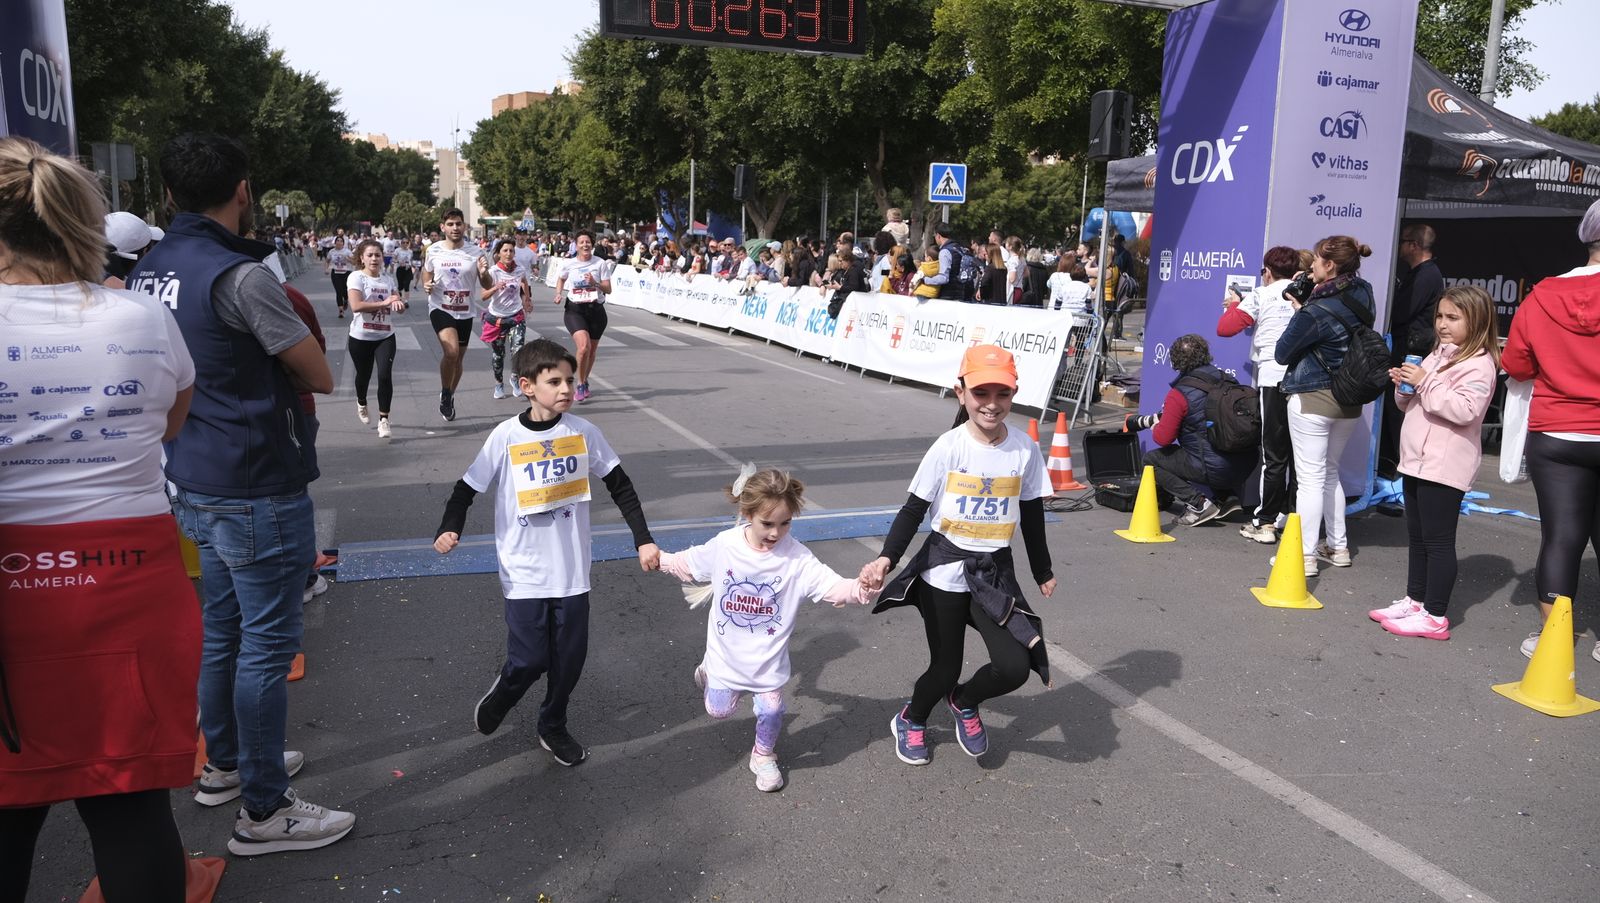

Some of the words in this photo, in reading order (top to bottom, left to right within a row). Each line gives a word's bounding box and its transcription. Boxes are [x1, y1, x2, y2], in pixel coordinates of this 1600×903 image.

[1325, 32, 1380, 49] HYUNDAI
[1331, 46, 1373, 60] Almerialva
[21, 48, 66, 126] CDX
[1335, 75, 1380, 90] cajamar
[1320, 116, 1359, 139] CASI
[1171, 133, 1243, 185] CDX
[1329, 155, 1369, 171] vithas
[1316, 203, 1362, 220] aqualia
[1182, 249, 1245, 268] ALMERÍA
[1181, 269, 1211, 280] CIUDAD
[913, 320, 965, 344] ALMERÍA
[31, 345, 82, 354] ALMERÍA
[994, 331, 1057, 354] ALMERÍA
[49, 386, 92, 394] cajamar
[104, 384, 139, 396] CASI
[34, 413, 68, 421] aqualia
[76, 456, 117, 464] ALMERÍA
[524, 456, 578, 481] 1750
[542, 476, 565, 485] ARTURO
[956, 496, 1009, 516] 1751
[9, 573, 97, 590] ALMERÍA
[725, 601, 774, 615] RUNNER
[736, 594, 764, 606] MINI
